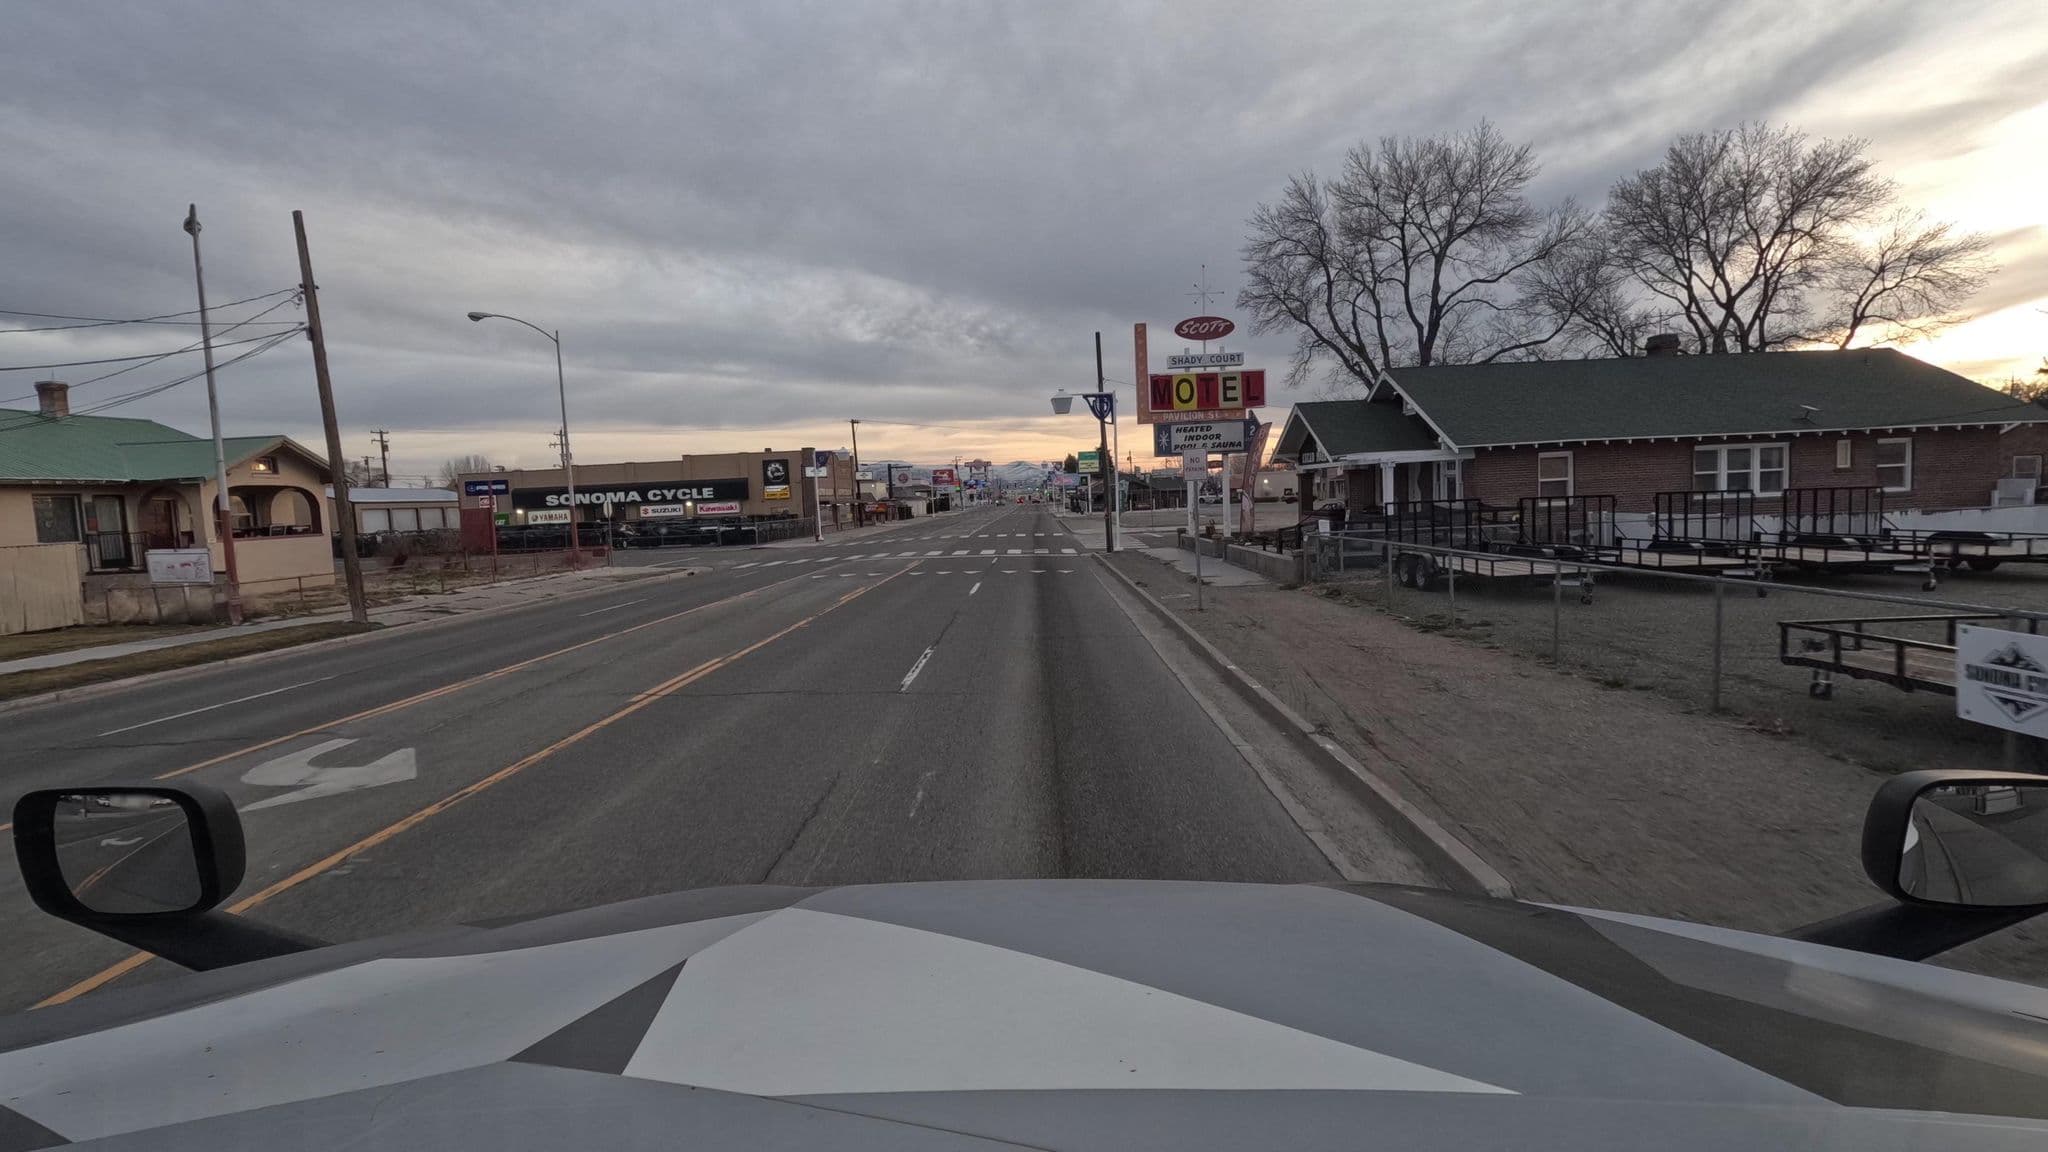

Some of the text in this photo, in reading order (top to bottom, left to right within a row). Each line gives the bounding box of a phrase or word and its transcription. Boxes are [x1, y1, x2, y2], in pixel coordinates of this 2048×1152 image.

[1179, 320, 1231, 335] SCOTT
[1171, 354, 1242, 366] SHADY COURT
[1152, 375, 1260, 405] MOTEL
[1163, 412, 1204, 421] PAVILION
[1175, 425, 1213, 434] HEATED
[1184, 433, 1222, 442] INDOOR
[1210, 441, 1243, 449] SAUNA
[1189, 456, 1201, 464] NO
[546, 487, 714, 506] SONOMA CYCLE
[699, 504, 737, 513] Kawasaki
[539, 513, 569, 522] YAMAHA
